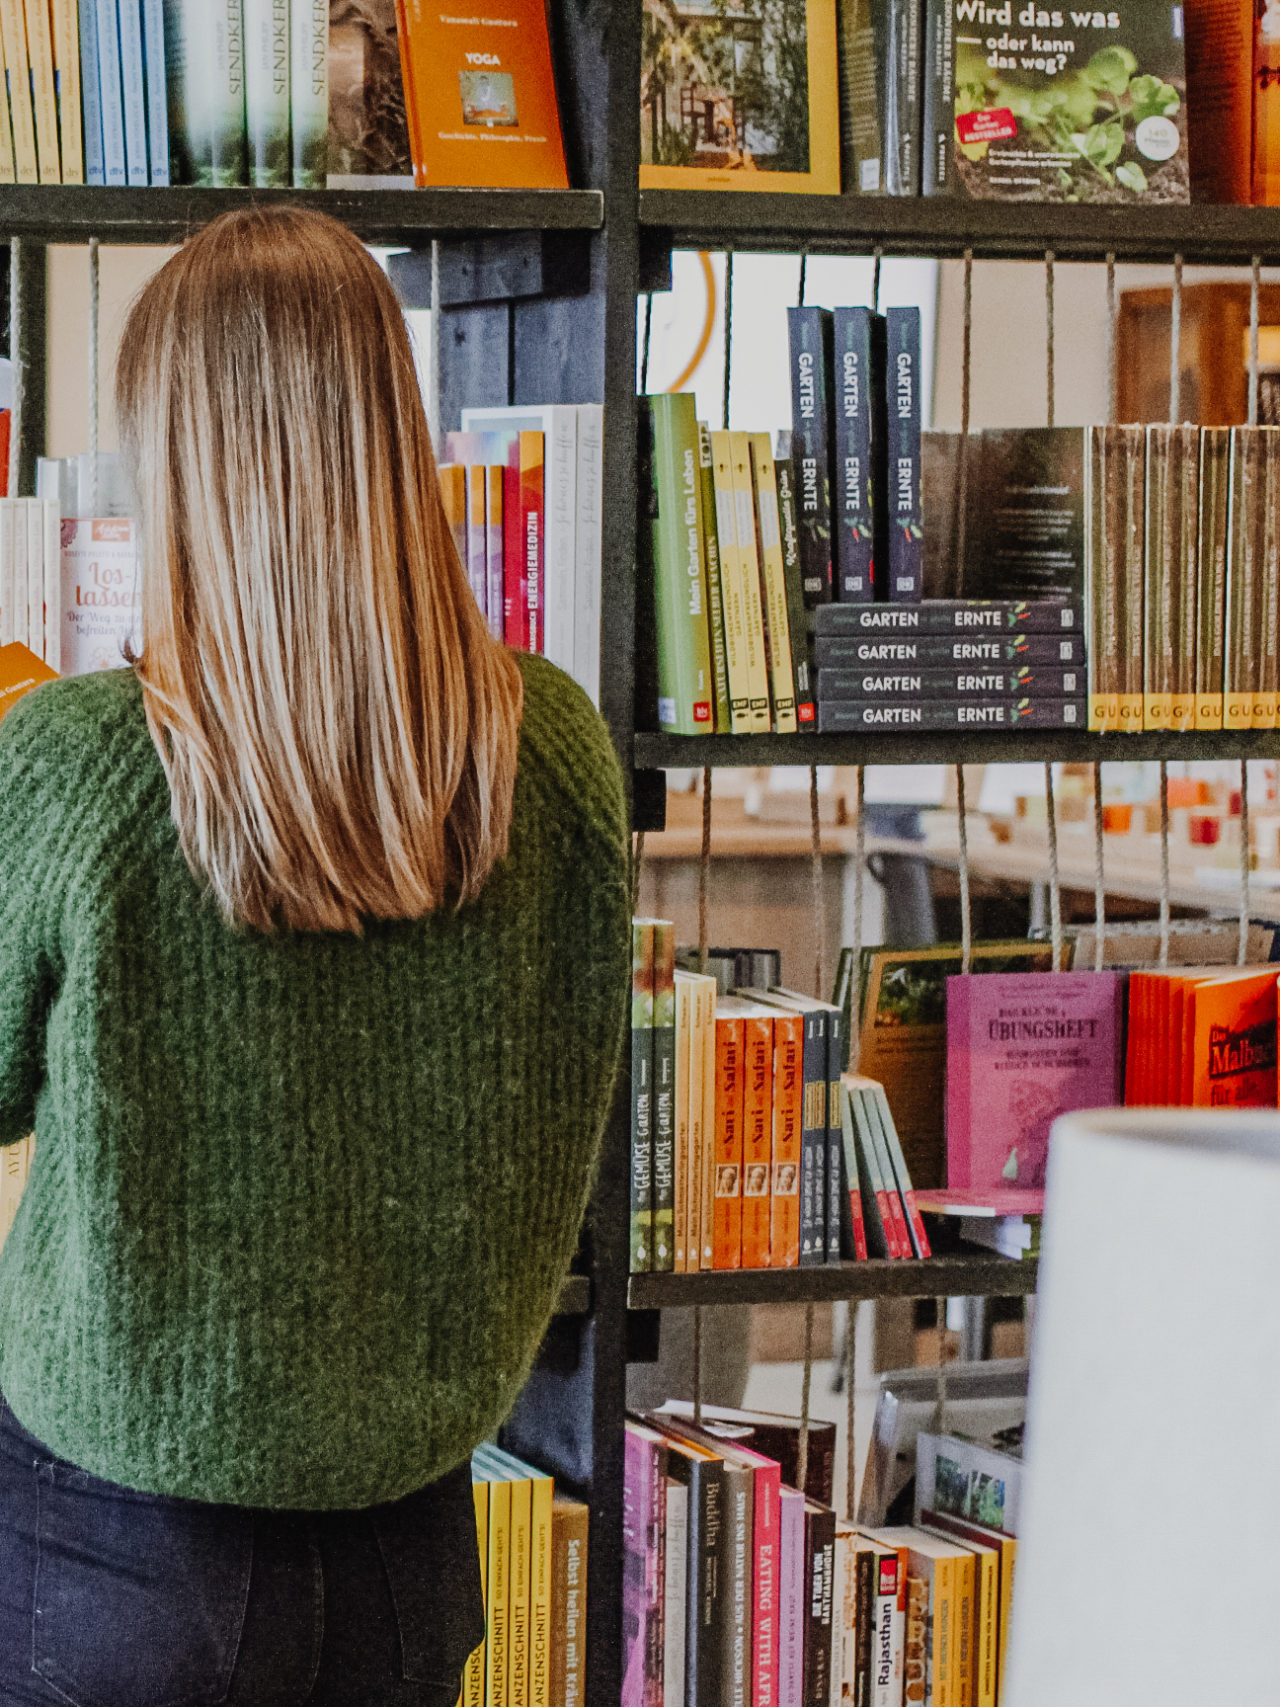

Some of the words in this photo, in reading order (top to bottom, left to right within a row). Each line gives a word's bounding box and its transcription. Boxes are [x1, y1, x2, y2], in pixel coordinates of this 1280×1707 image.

[956, 0, 1012, 26] Wird
[1019, 1, 1064, 28] das
[1070, 10, 1121, 29] was
[464, 52, 501, 66] YOGA
[986, 32, 1028, 52] oder
[1031, 33, 1075, 53] kann
[986, 51, 1017, 70] das
[1020, 53, 1067, 75] weg?
[798, 352, 814, 418] GARTEN
[843, 351, 858, 417] GARTEN
[897, 352, 912, 418] GARTEN
[682, 449, 697, 494] Leben
[801, 457, 817, 511] ERNTE
[845, 456, 860, 510] ERNTE
[897, 457, 912, 511] ERNTE
[684, 496, 699, 526] fürs
[686, 526, 701, 577] Garten
[782, 500, 797, 566] Kraftquelle
[527, 511, 539, 610] ENERGIEMEDIZIN
[706, 535, 720, 587] MACHEN
[687, 579, 702, 616] Mein
[710, 587, 723, 628] SELBER
[860, 611, 919, 627] GARTEN
[954, 611, 1002, 626] ERNTE
[858, 644, 917, 660] GARTEN
[953, 643, 1000, 659] ERNTE
[862, 676, 921, 692] GARTEN
[957, 675, 1004, 690] ERNTE
[862, 708, 921, 723] GARTEN
[957, 707, 1005, 722] ERNTE
[723, 1039, 737, 1093] Safari
[752, 1039, 766, 1092] Safari
[782, 1039, 796, 1091] Safari
[722, 1109, 736, 1144] Sari
[751, 1108, 765, 1143] Sari
[781, 1107, 795, 1143] Sari
[705, 1482, 721, 1546] Buddha
[736, 1491, 746, 1521] HAUS
[736, 1522, 745, 1541] INS
[567, 1539, 580, 1586] Selbst
[735, 1543, 745, 1578] NATUR
[759, 1543, 773, 1611] EATING
[813, 1552, 824, 1573] VON
[735, 1580, 744, 1602] DER
[566, 1589, 579, 1638] heilen
[566, 1642, 579, 1669] mit
[758, 1617, 772, 1665] WITH
[877, 1602, 893, 1687] Rajasthan
